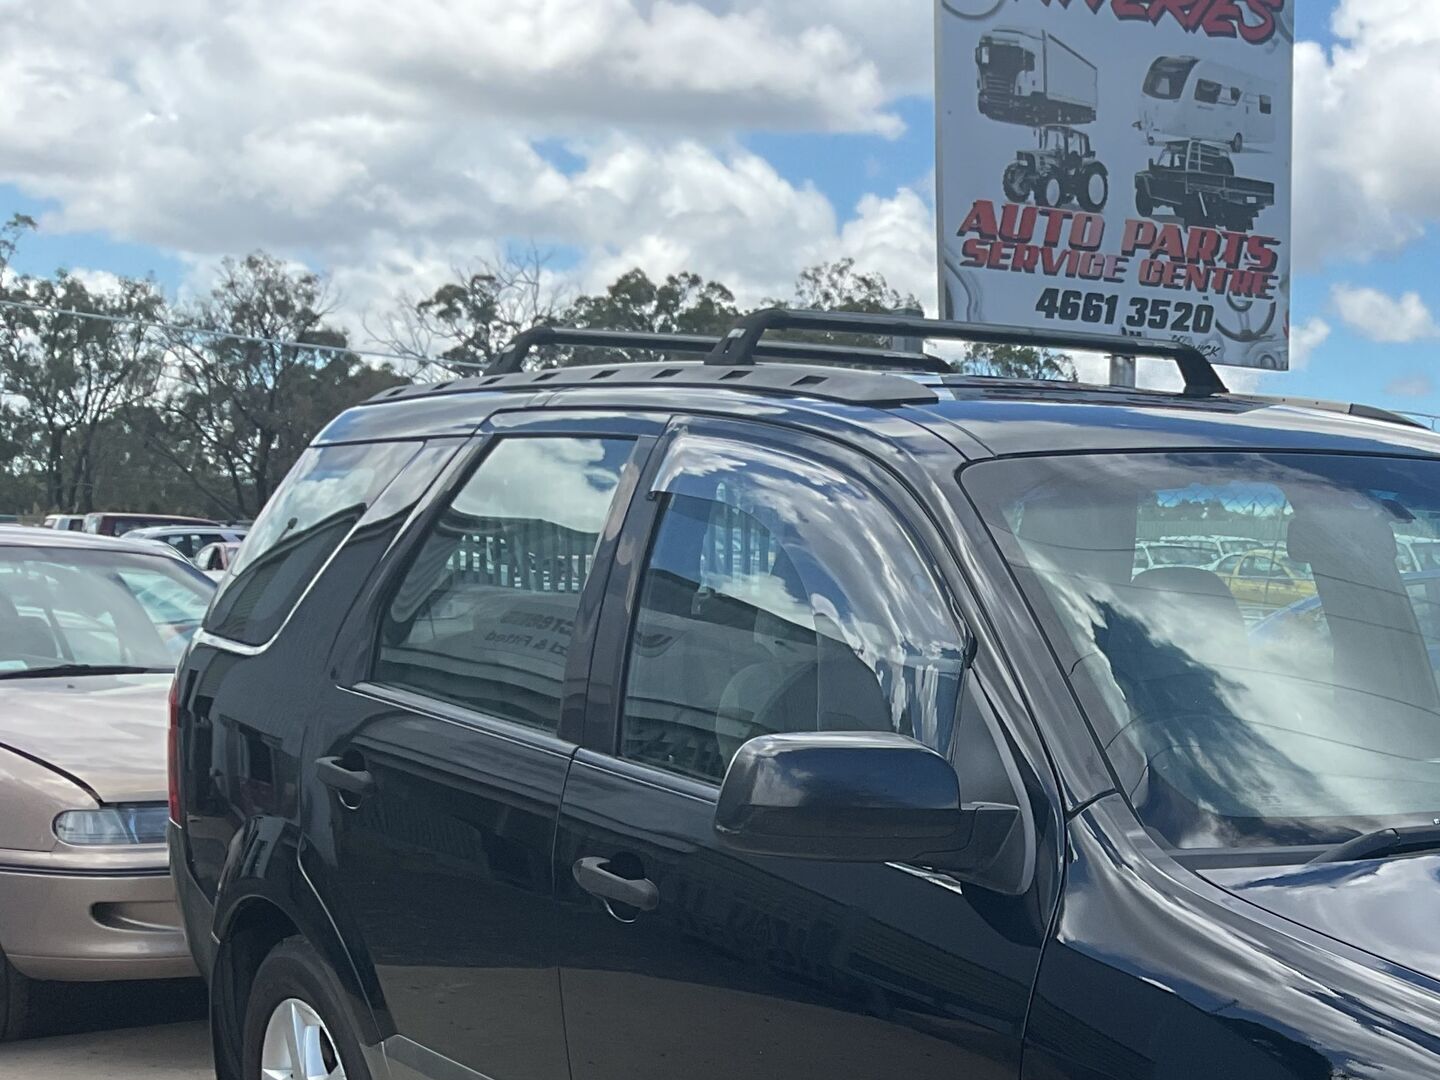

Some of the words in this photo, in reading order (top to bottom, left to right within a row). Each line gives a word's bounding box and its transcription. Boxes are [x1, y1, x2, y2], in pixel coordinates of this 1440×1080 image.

[956, 199, 1105, 251] AUTO
[1121, 219, 1281, 272] PARTS
[959, 238, 1129, 283] SERVICE
[1139, 259, 1278, 300] CENTRE
[1035, 287, 1119, 325] 4661
[1125, 297, 1214, 334] 3520
